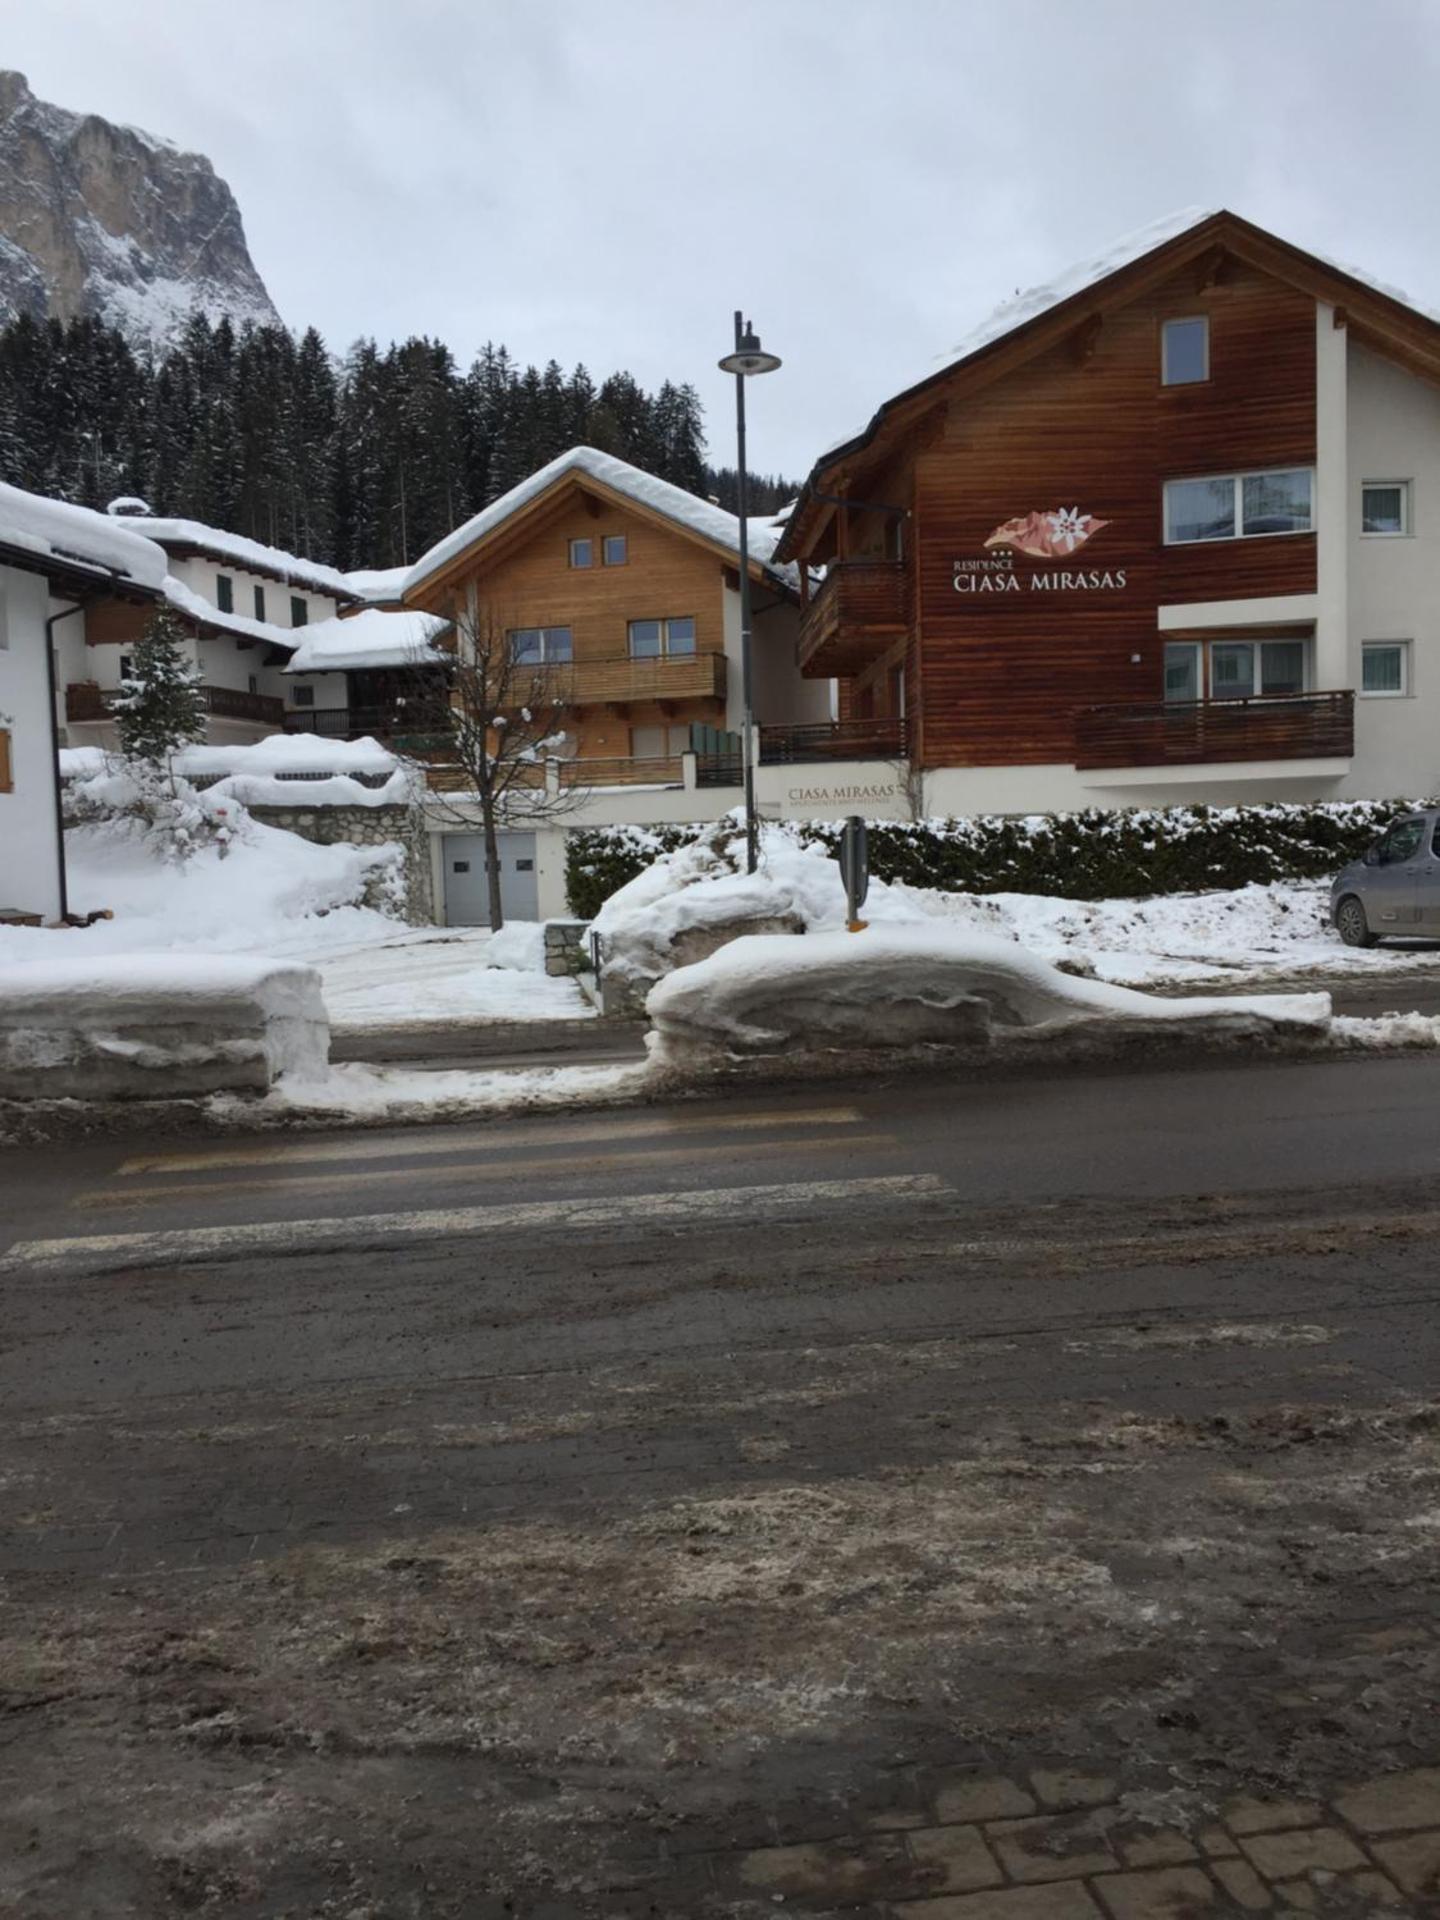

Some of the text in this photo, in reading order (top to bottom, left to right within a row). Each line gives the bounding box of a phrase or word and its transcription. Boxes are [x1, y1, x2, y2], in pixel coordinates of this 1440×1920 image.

[953, 559, 1014, 571] RESIDENCE
[953, 569, 1127, 593] CIASA MIRASAS
[788, 783, 894, 801] CIASA MIRASAS
